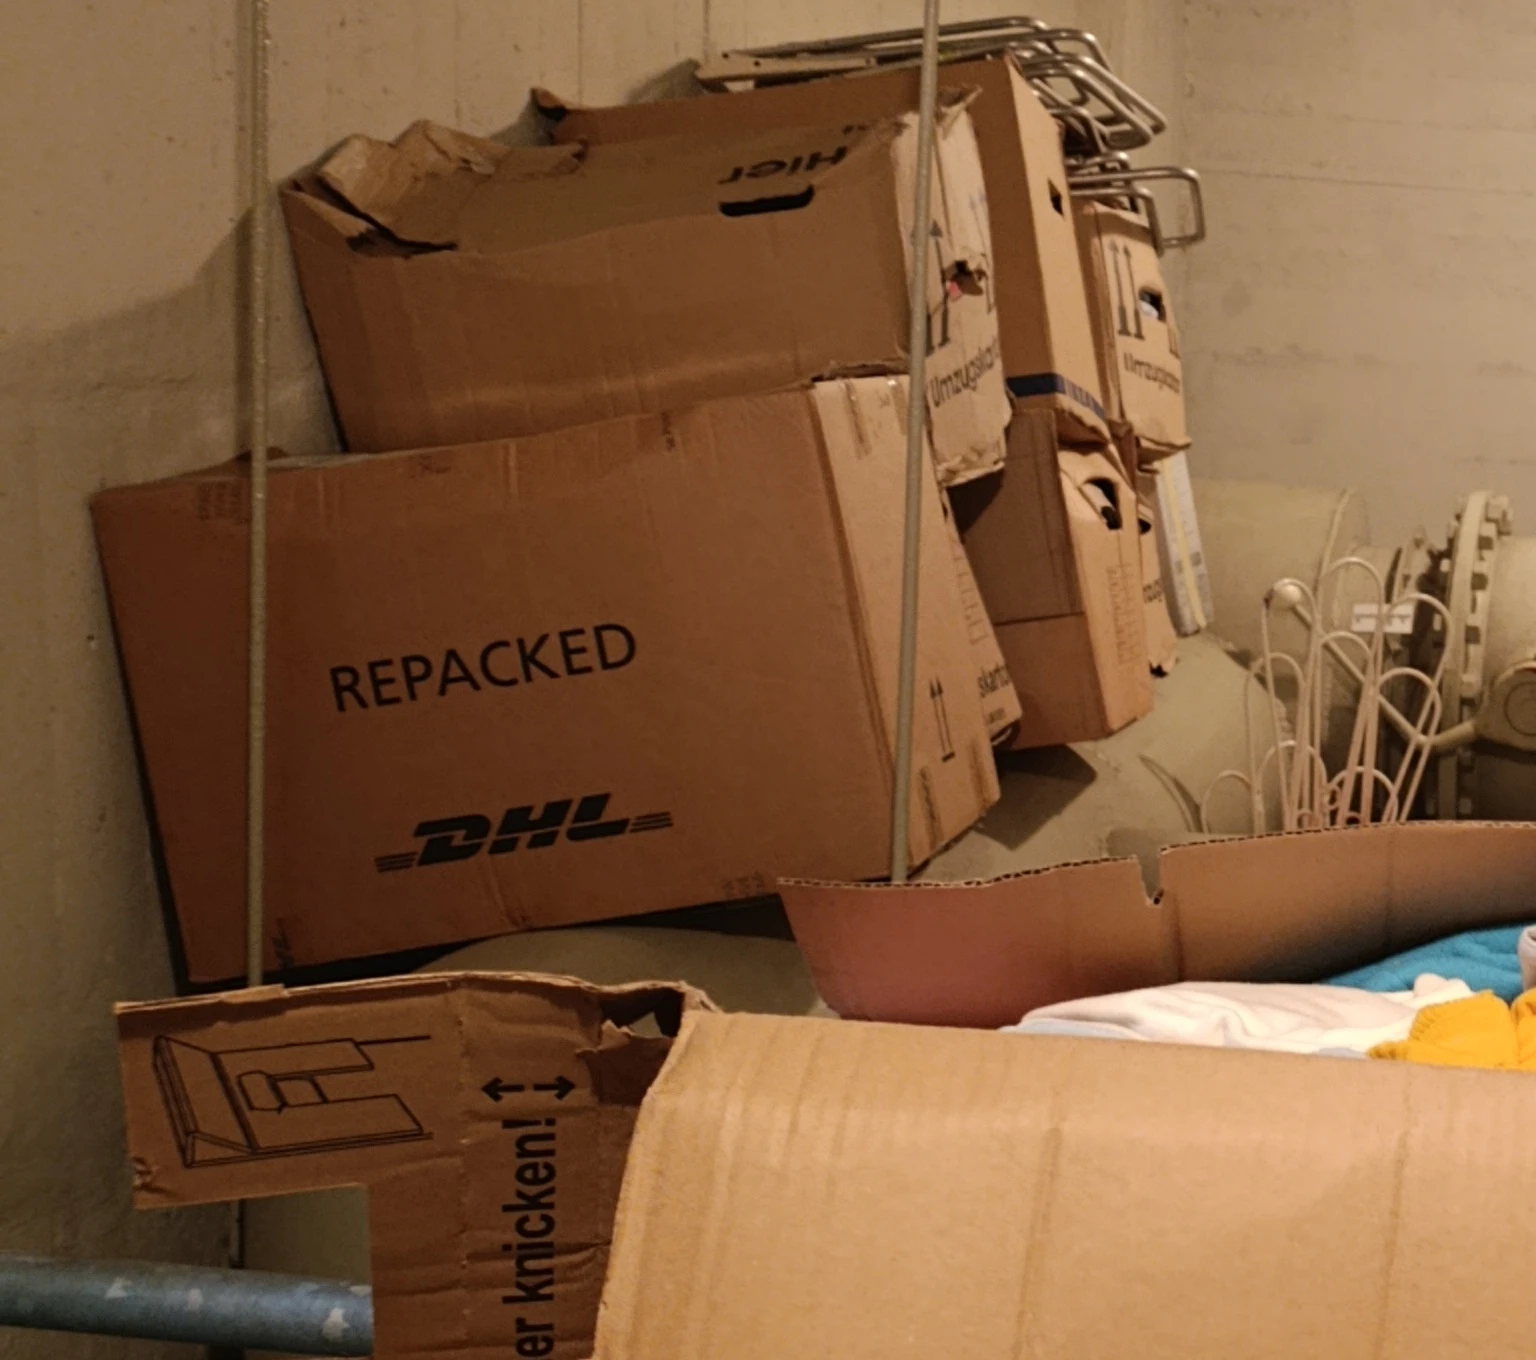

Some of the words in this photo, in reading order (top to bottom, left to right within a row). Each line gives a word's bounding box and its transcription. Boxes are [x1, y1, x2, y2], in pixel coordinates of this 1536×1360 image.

[330, 623, 636, 712] REPACKED
[413, 793, 630, 867] DHL
[503, 1116, 557, 1307] knicken!
